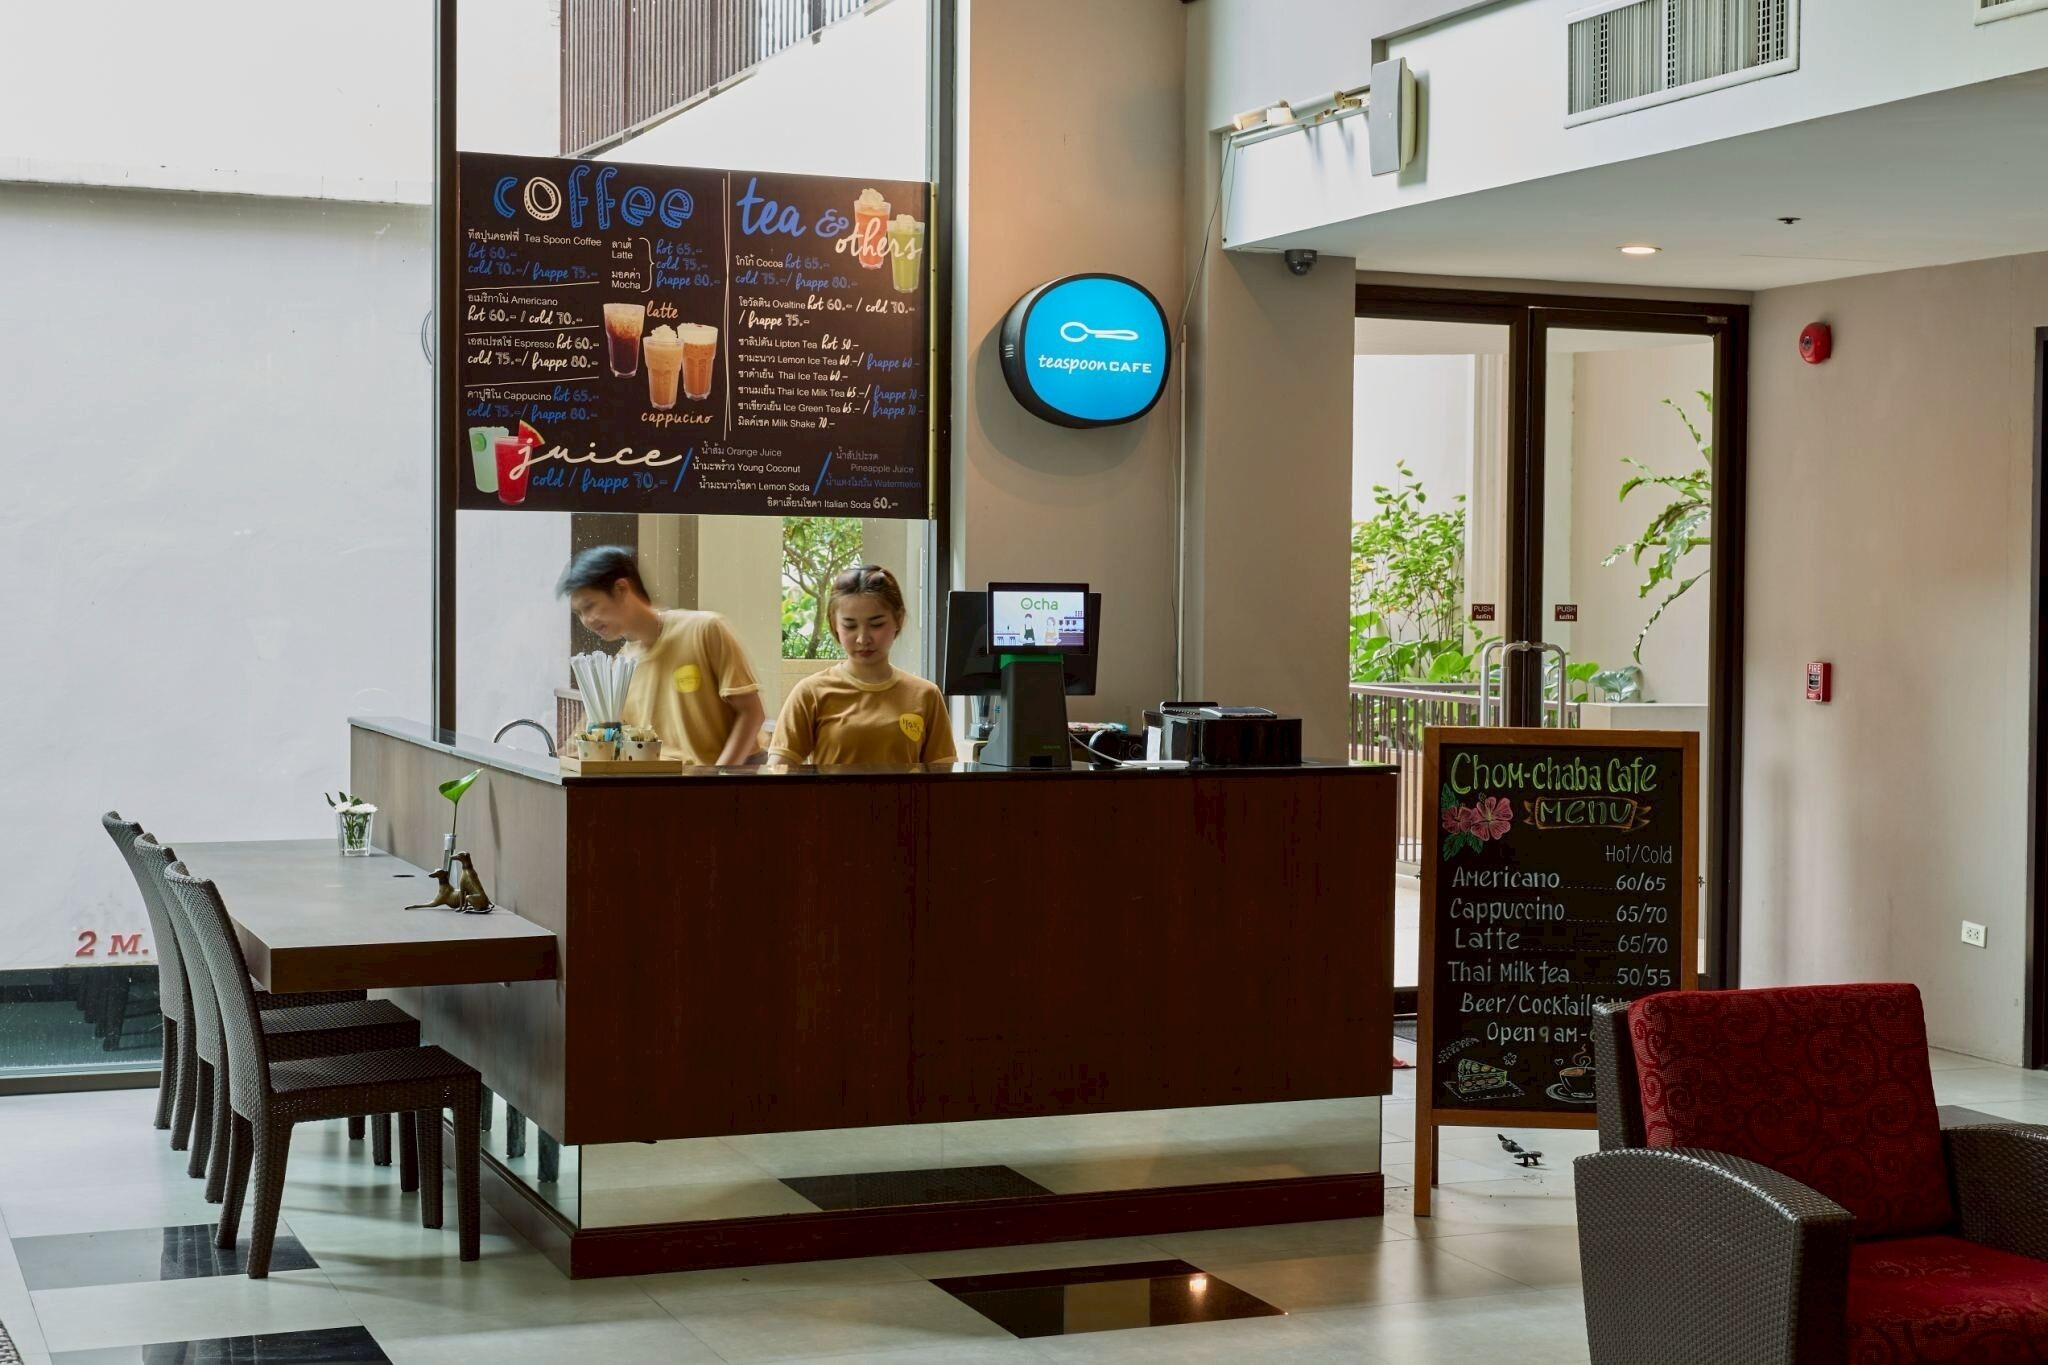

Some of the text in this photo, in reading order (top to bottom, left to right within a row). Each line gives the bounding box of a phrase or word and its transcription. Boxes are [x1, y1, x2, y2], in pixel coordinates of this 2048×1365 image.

[494, 164, 694, 230] coffee
[736, 177, 806, 237] tea
[524, 234, 540, 243] Tea
[544, 235, 571, 246] Spoon
[574, 237, 602, 246] Coffee
[656, 239, 672, 254] hot
[836, 218, 922, 260] others
[468, 242, 486, 258] hot
[612, 251, 633, 259] Latte
[656, 256, 680, 270] cold
[756, 258, 784, 268] Cocoa
[785, 253, 802, 268] hot
[468, 260, 492, 274] cold
[532, 262, 569, 282] frappe
[656, 270, 690, 290] frappe
[612, 281, 640, 290] Mocha
[736, 271, 757, 284] cold
[796, 273, 829, 292] frappe
[511, 296, 558, 306] Americano
[647, 300, 678, 318] latte
[772, 300, 805, 310] Ovaltine
[808, 294, 824, 310] hot
[866, 300, 888, 314] cold
[468, 305, 486, 321] hot
[489, 309, 516, 322] 60.-
[529, 309, 553, 324] cold
[749, 310, 782, 330] frappe
[514, 340, 555, 349] Espresso
[556, 334, 572, 350] hot
[774, 340, 800, 349] Lipton
[802, 340, 817, 348] Tea
[822, 334, 838, 350] hot
[468, 350, 492, 365] cold
[532, 352, 568, 371] frappe
[778, 356, 805, 364] Lemon
[822, 357, 838, 366] Tea
[867, 352, 900, 372] frappe
[778, 371, 796, 380] Thai
[798, 372, 810, 380] Ice
[813, 372, 828, 380] Tea
[504, 390, 551, 402] Cappucino
[554, 385, 570, 400] hot
[778, 387, 794, 396] Thai
[797, 388, 810, 396] Ice
[812, 388, 828, 396] Milk
[830, 389, 845, 398] Tea
[874, 384, 906, 403] frappe
[467, 404, 492, 418] cold
[531, 404, 566, 423] frappe
[641, 411, 713, 428] cappucino
[784, 404, 796, 412] Ice
[798, 404, 824, 412] Green
[826, 405, 840, 413] Tea
[872, 400, 904, 420] frappe
[790, 420, 816, 428] Shake
[510, 438, 682, 480] juice
[727, 447, 758, 457] Orange
[760, 448, 782, 456] Juice
[738, 464, 764, 474] Young
[766, 464, 800, 472] Coconut
[850, 464, 914, 474] Pineapple Juice
[532, 468, 564, 488] cold
[581, 470, 628, 492] frappe
[759, 482, 786, 490] Lemon
[788, 483, 810, 492] Soda
[874, 480, 921, 488] Watermelon
[824, 500, 848, 508] Italian
[1020, 598, 1058, 610] Ocha
[1606, 756, 1657, 794] Cafe
[1606, 844, 1672, 864] Hot/Cold
[1452, 866, 1666, 891] Americano 60/65
[1450, 896, 1668, 924] Cappuccino 65/70
[76, 930, 148, 957] 2 M.
[1455, 928, 1668, 954] Latte 65/70
[1448, 958, 1671, 986] Thai Milk tea 50/55
[1487, 1022, 1535, 1046] Open
